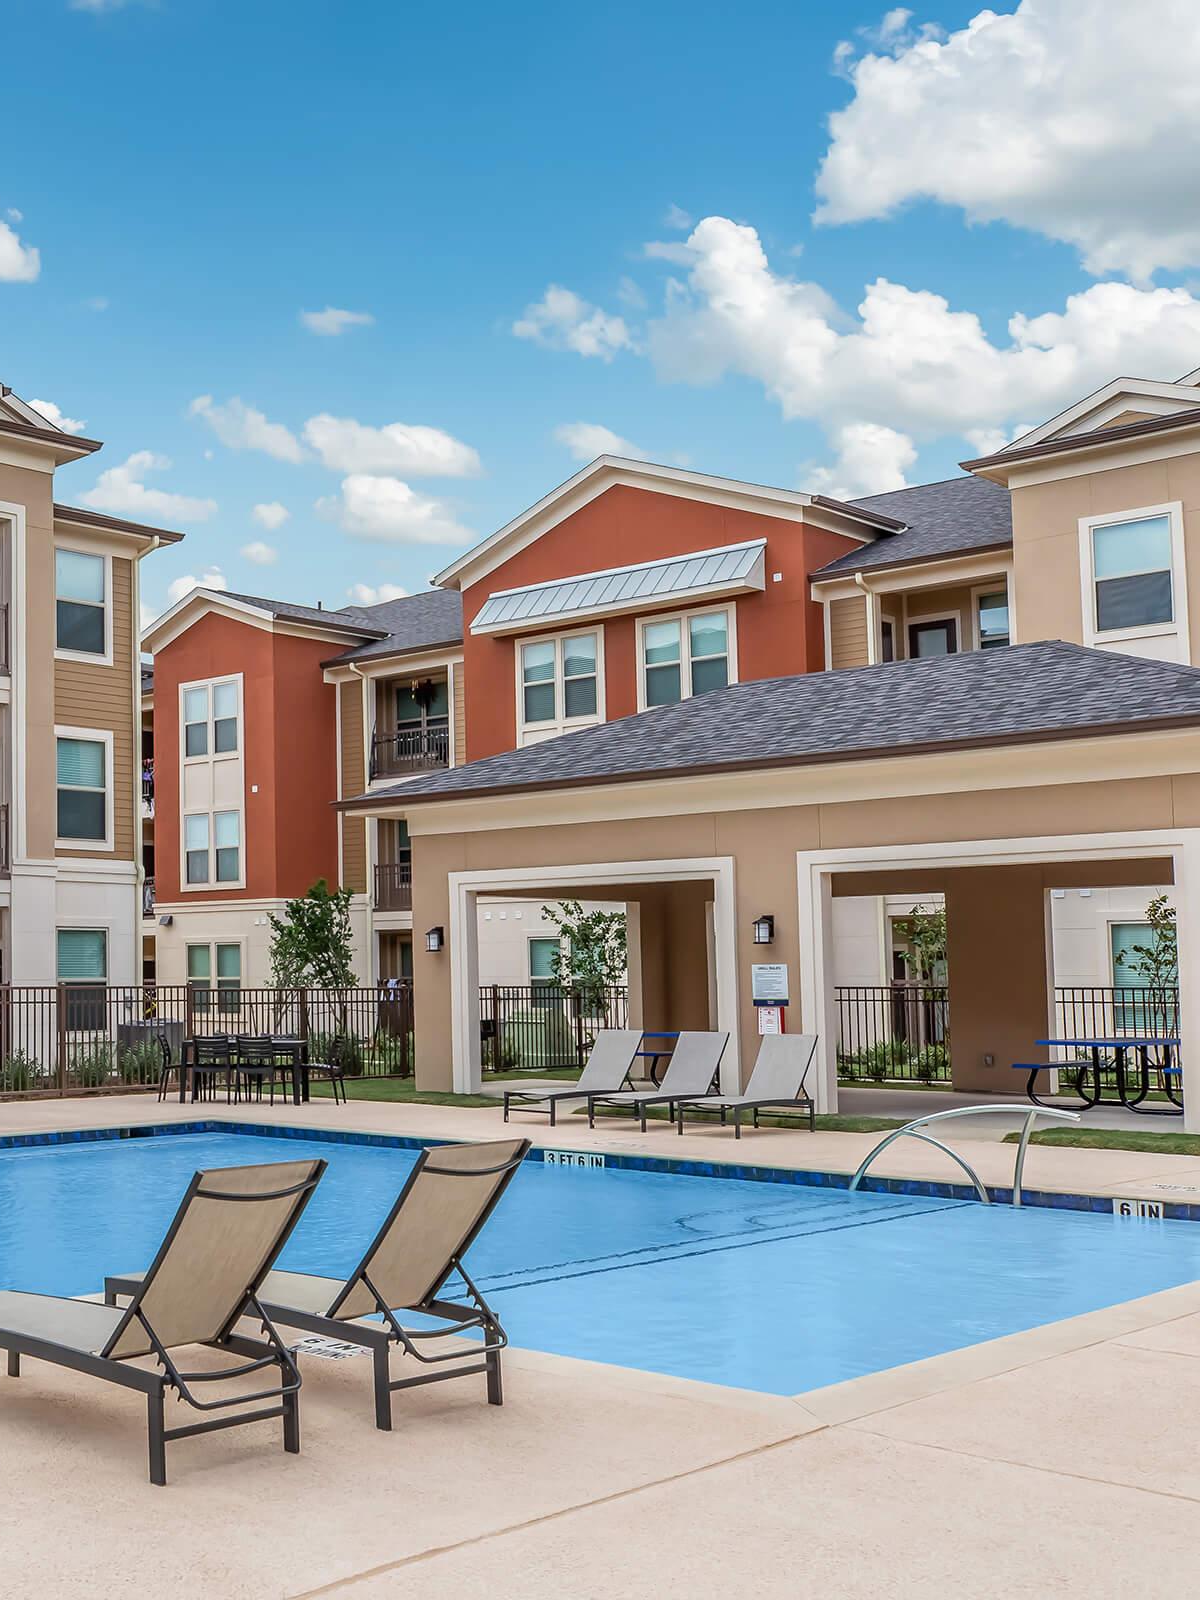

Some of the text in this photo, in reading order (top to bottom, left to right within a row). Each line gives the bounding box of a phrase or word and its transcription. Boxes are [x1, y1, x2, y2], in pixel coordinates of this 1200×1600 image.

[548, 1153, 603, 1168] 3 FT 6 IN
[1120, 1202, 1160, 1218] 6 IN
